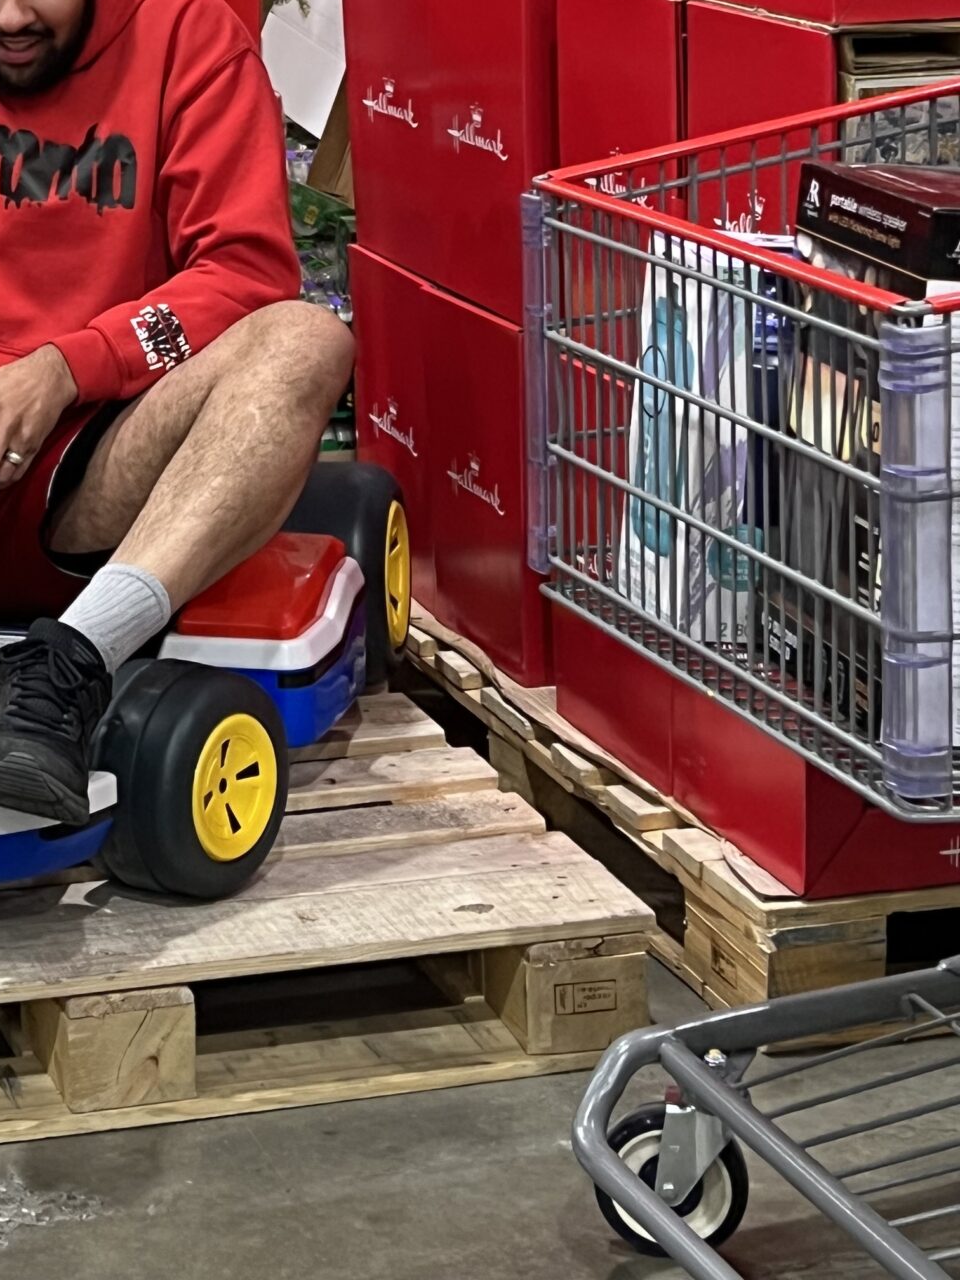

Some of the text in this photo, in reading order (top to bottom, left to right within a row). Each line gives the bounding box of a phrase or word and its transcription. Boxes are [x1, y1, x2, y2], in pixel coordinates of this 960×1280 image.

[362, 86, 418, 128] Hallmark
[448, 114, 508, 161] Hallmark
[830, 193, 858, 213] portable
[130, 317, 163, 370] Label
[369, 403, 417, 457] Hallmark
[447, 457, 505, 516] Hallmark
